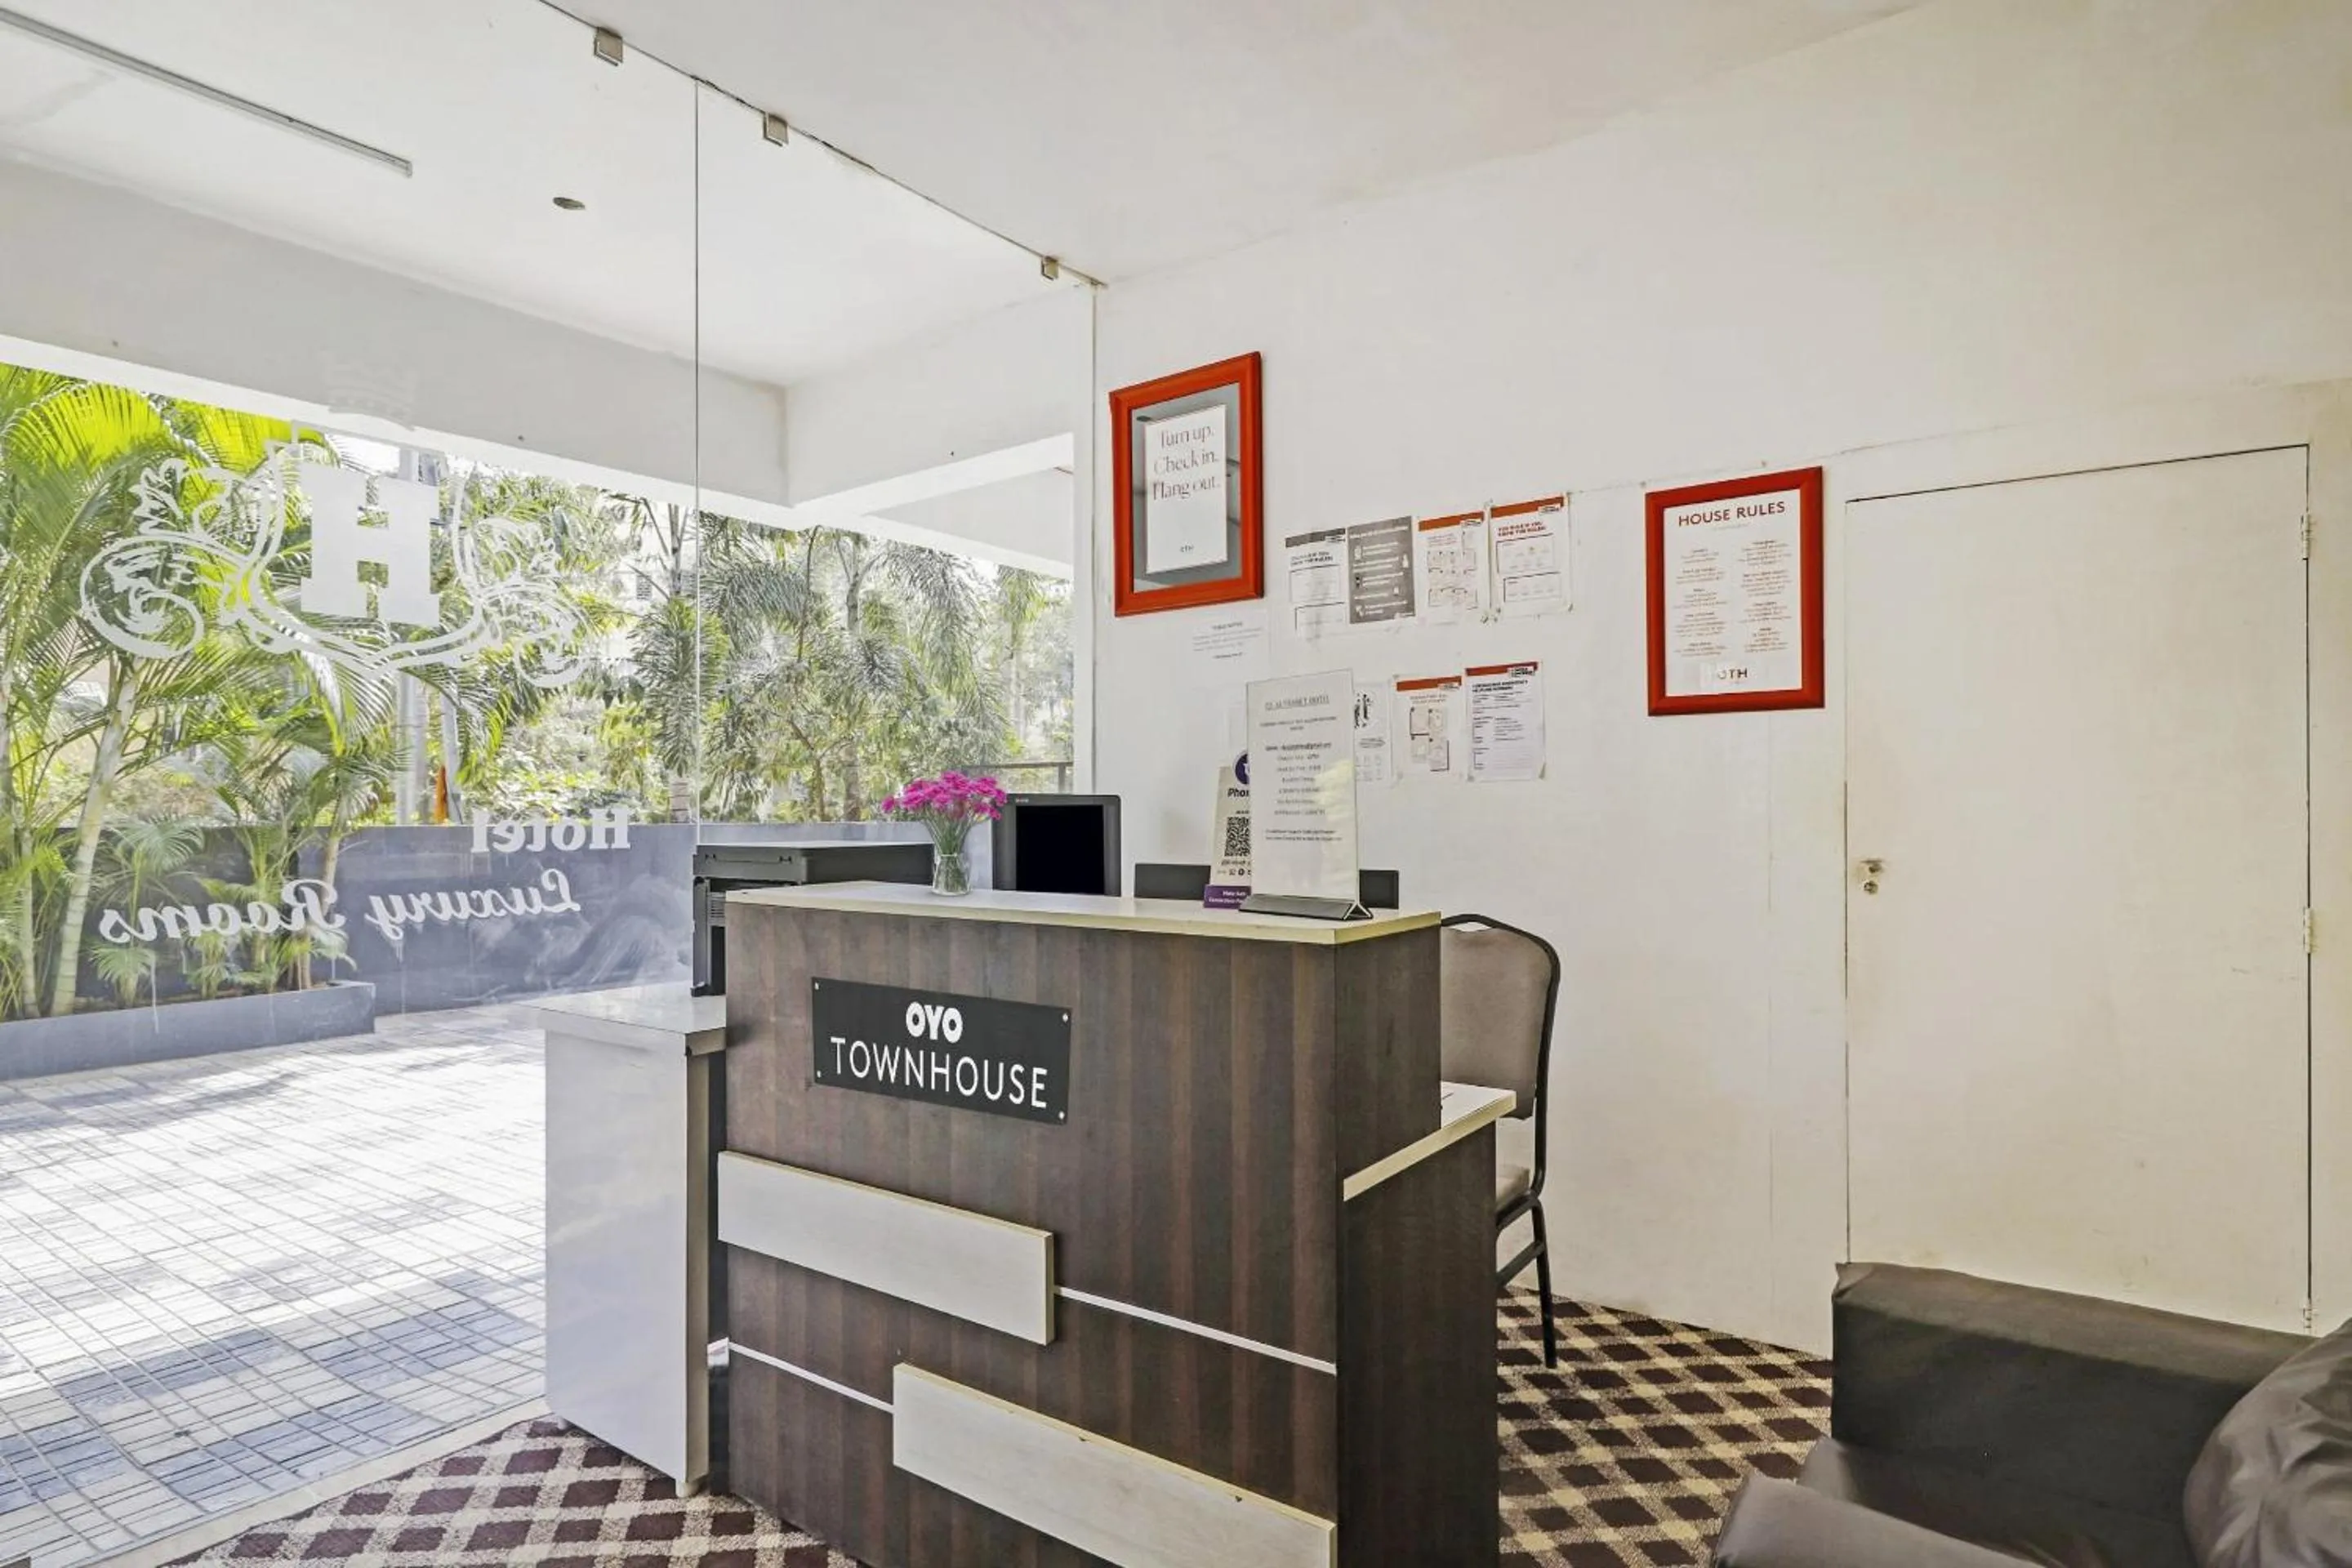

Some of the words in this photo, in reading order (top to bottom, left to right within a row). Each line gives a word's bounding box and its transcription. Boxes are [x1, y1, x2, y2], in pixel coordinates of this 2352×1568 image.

[1160, 430, 1189, 448] Turn
[1153, 450, 1199, 474] Check
[1153, 481, 1190, 500] Hang
[1678, 509, 1731, 527] HOUSE
[1736, 501, 1785, 519] RULES
[905, 1001, 964, 1044] OYO
[830, 1036, 1049, 1109] TOWNHOUSE
